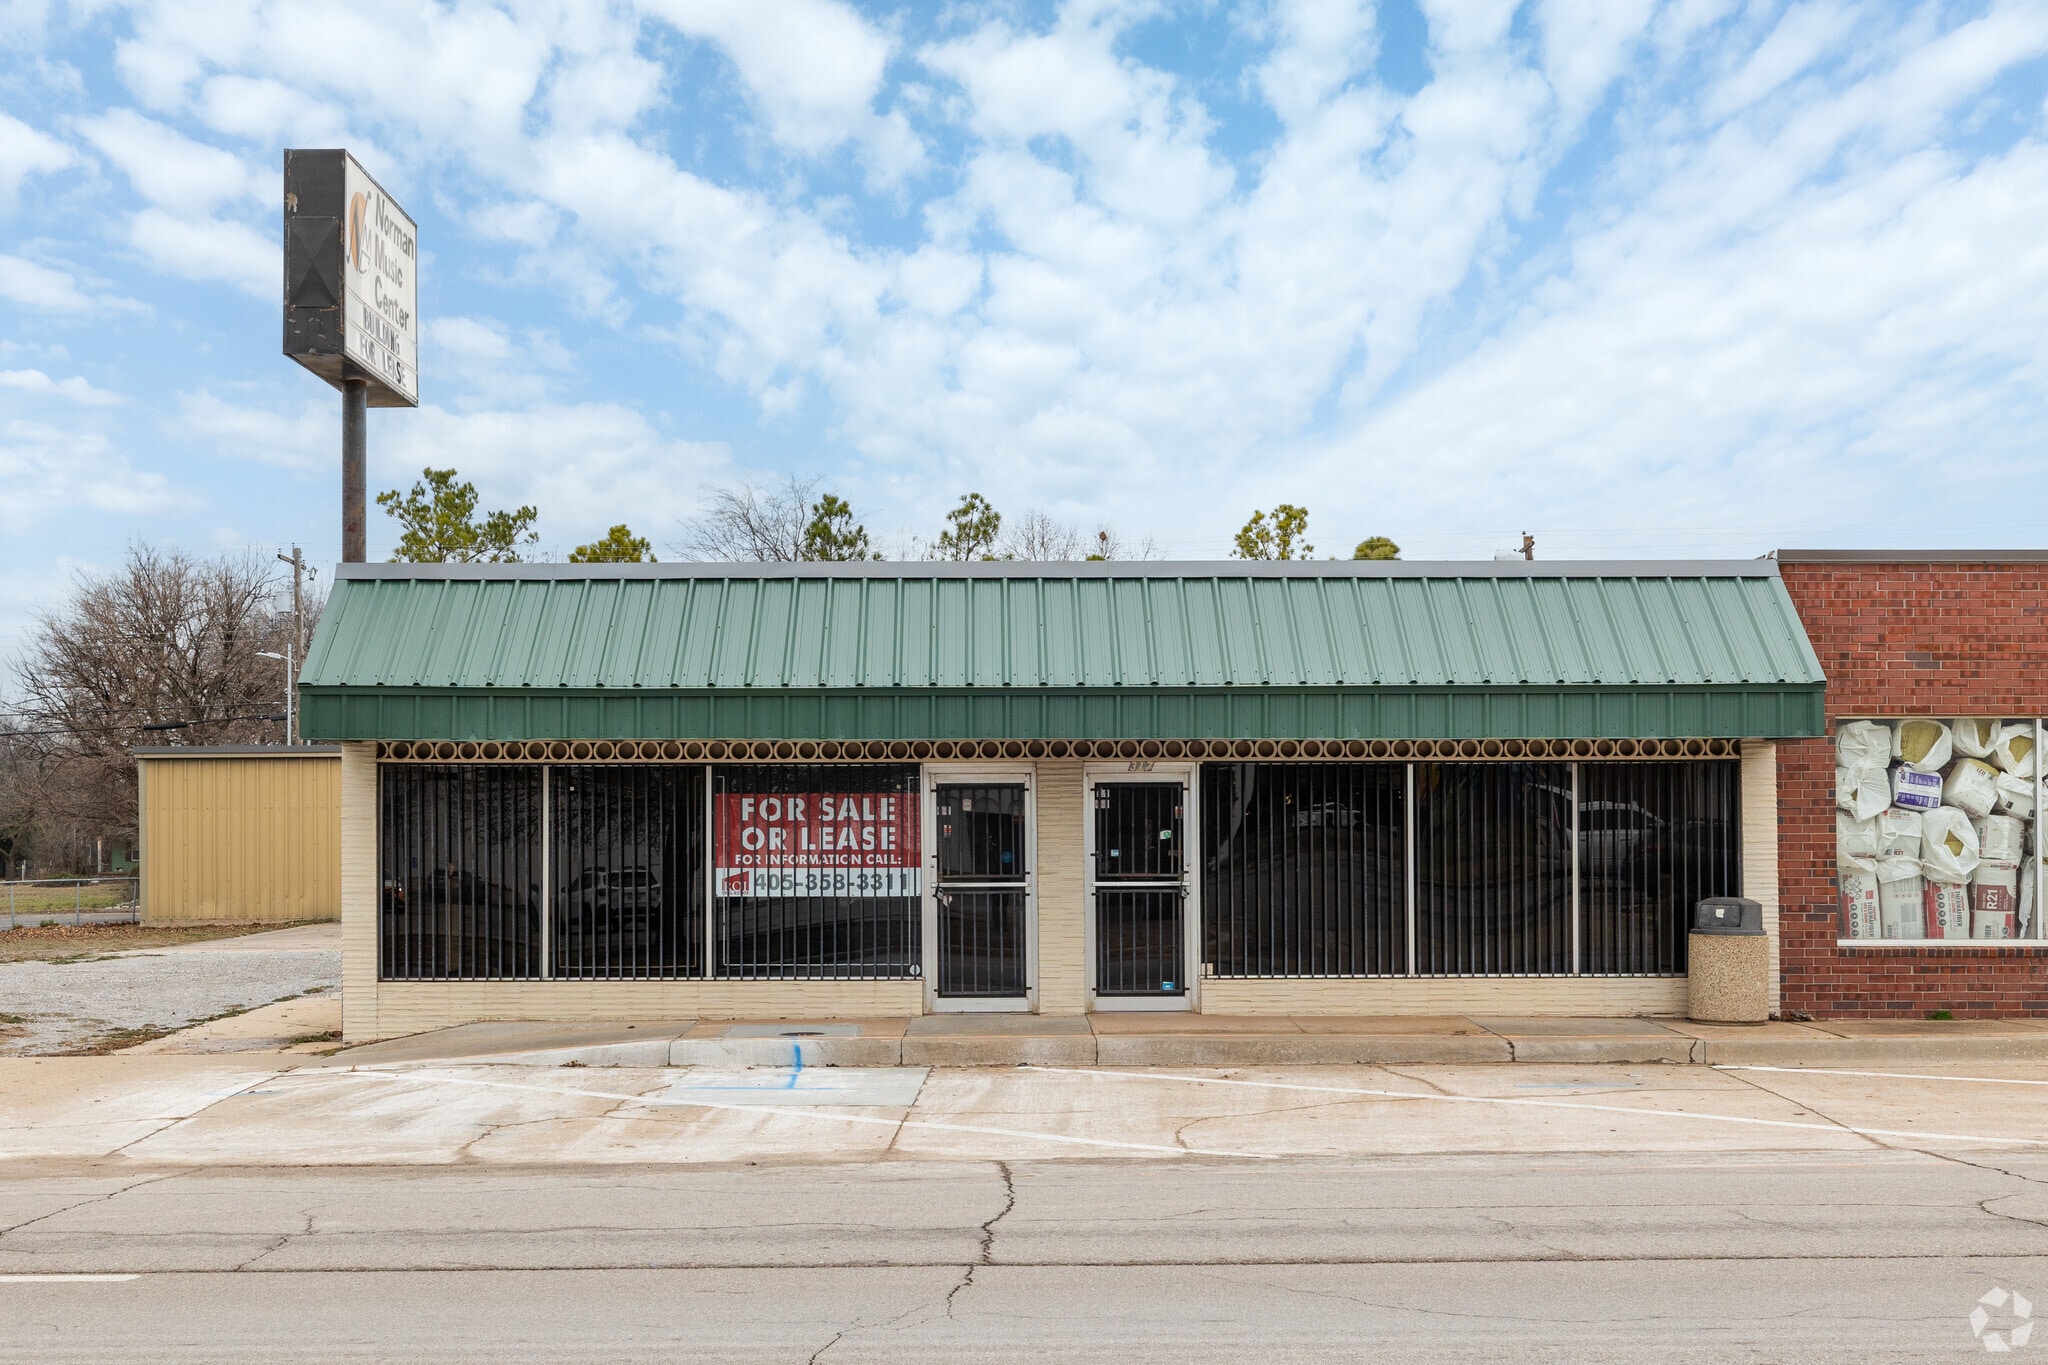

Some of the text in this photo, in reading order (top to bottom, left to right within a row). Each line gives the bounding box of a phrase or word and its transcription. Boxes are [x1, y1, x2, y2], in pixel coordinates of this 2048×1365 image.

[375, 193, 414, 260] Norman
[375, 234, 403, 288] Music
[375, 274, 410, 331] Center
[363, 306, 400, 356] BUILDING
[360, 333, 407, 388] FOR LEASE
[741, 797, 896, 821] FOR SALE
[741, 826, 896, 850] OR LEASE
[735, 854, 902, 865] FOR INFORMATION CALL:
[755, 873, 908, 891] 405-358-3311
[1986, 889, 1998, 910] R21
[1954, 890, 1963, 927] THERMAFIBER
